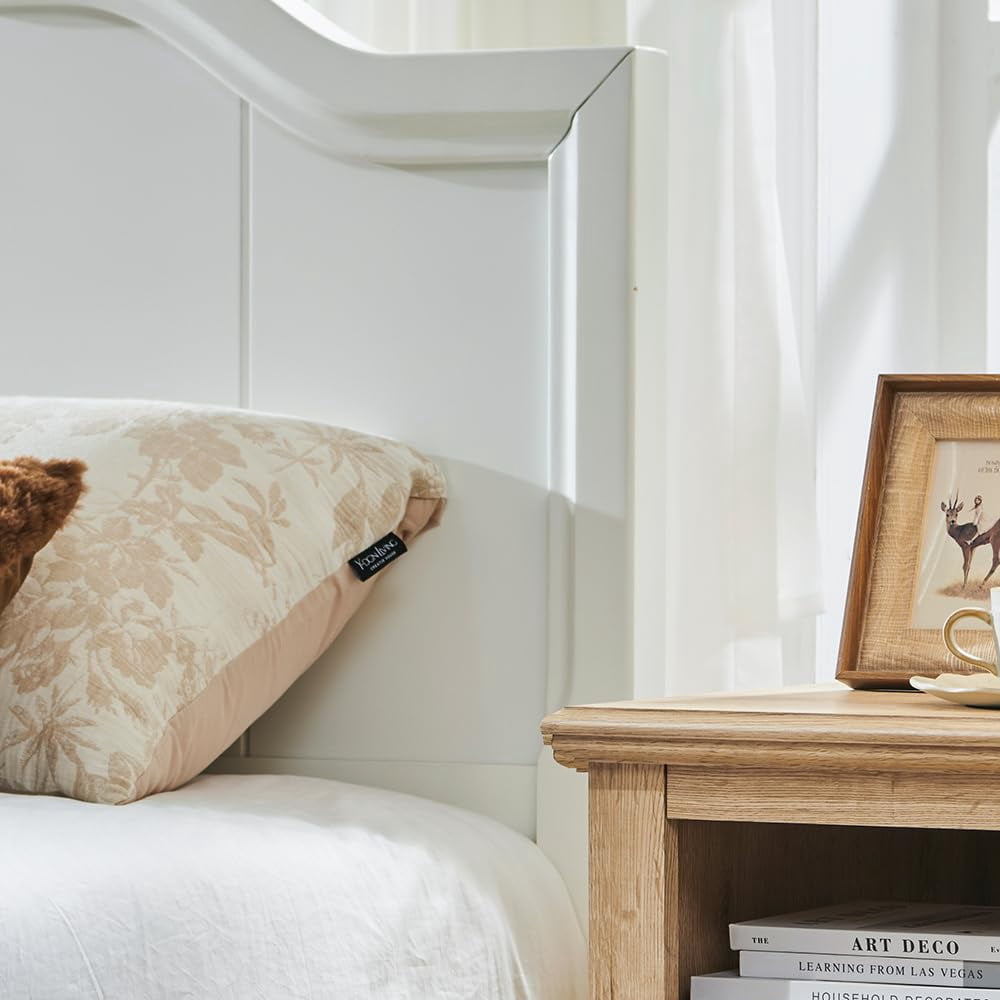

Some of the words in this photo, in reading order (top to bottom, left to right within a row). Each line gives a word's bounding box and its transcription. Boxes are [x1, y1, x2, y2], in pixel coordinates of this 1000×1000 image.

[852, 937, 891, 952] ART
[902, 938, 960, 955] DECO
[799, 961, 864, 974] LEARNING
[870, 965, 905, 976] FROM
[911, 966, 935, 977] LAS
[940, 967, 983, 980] VEGAS
